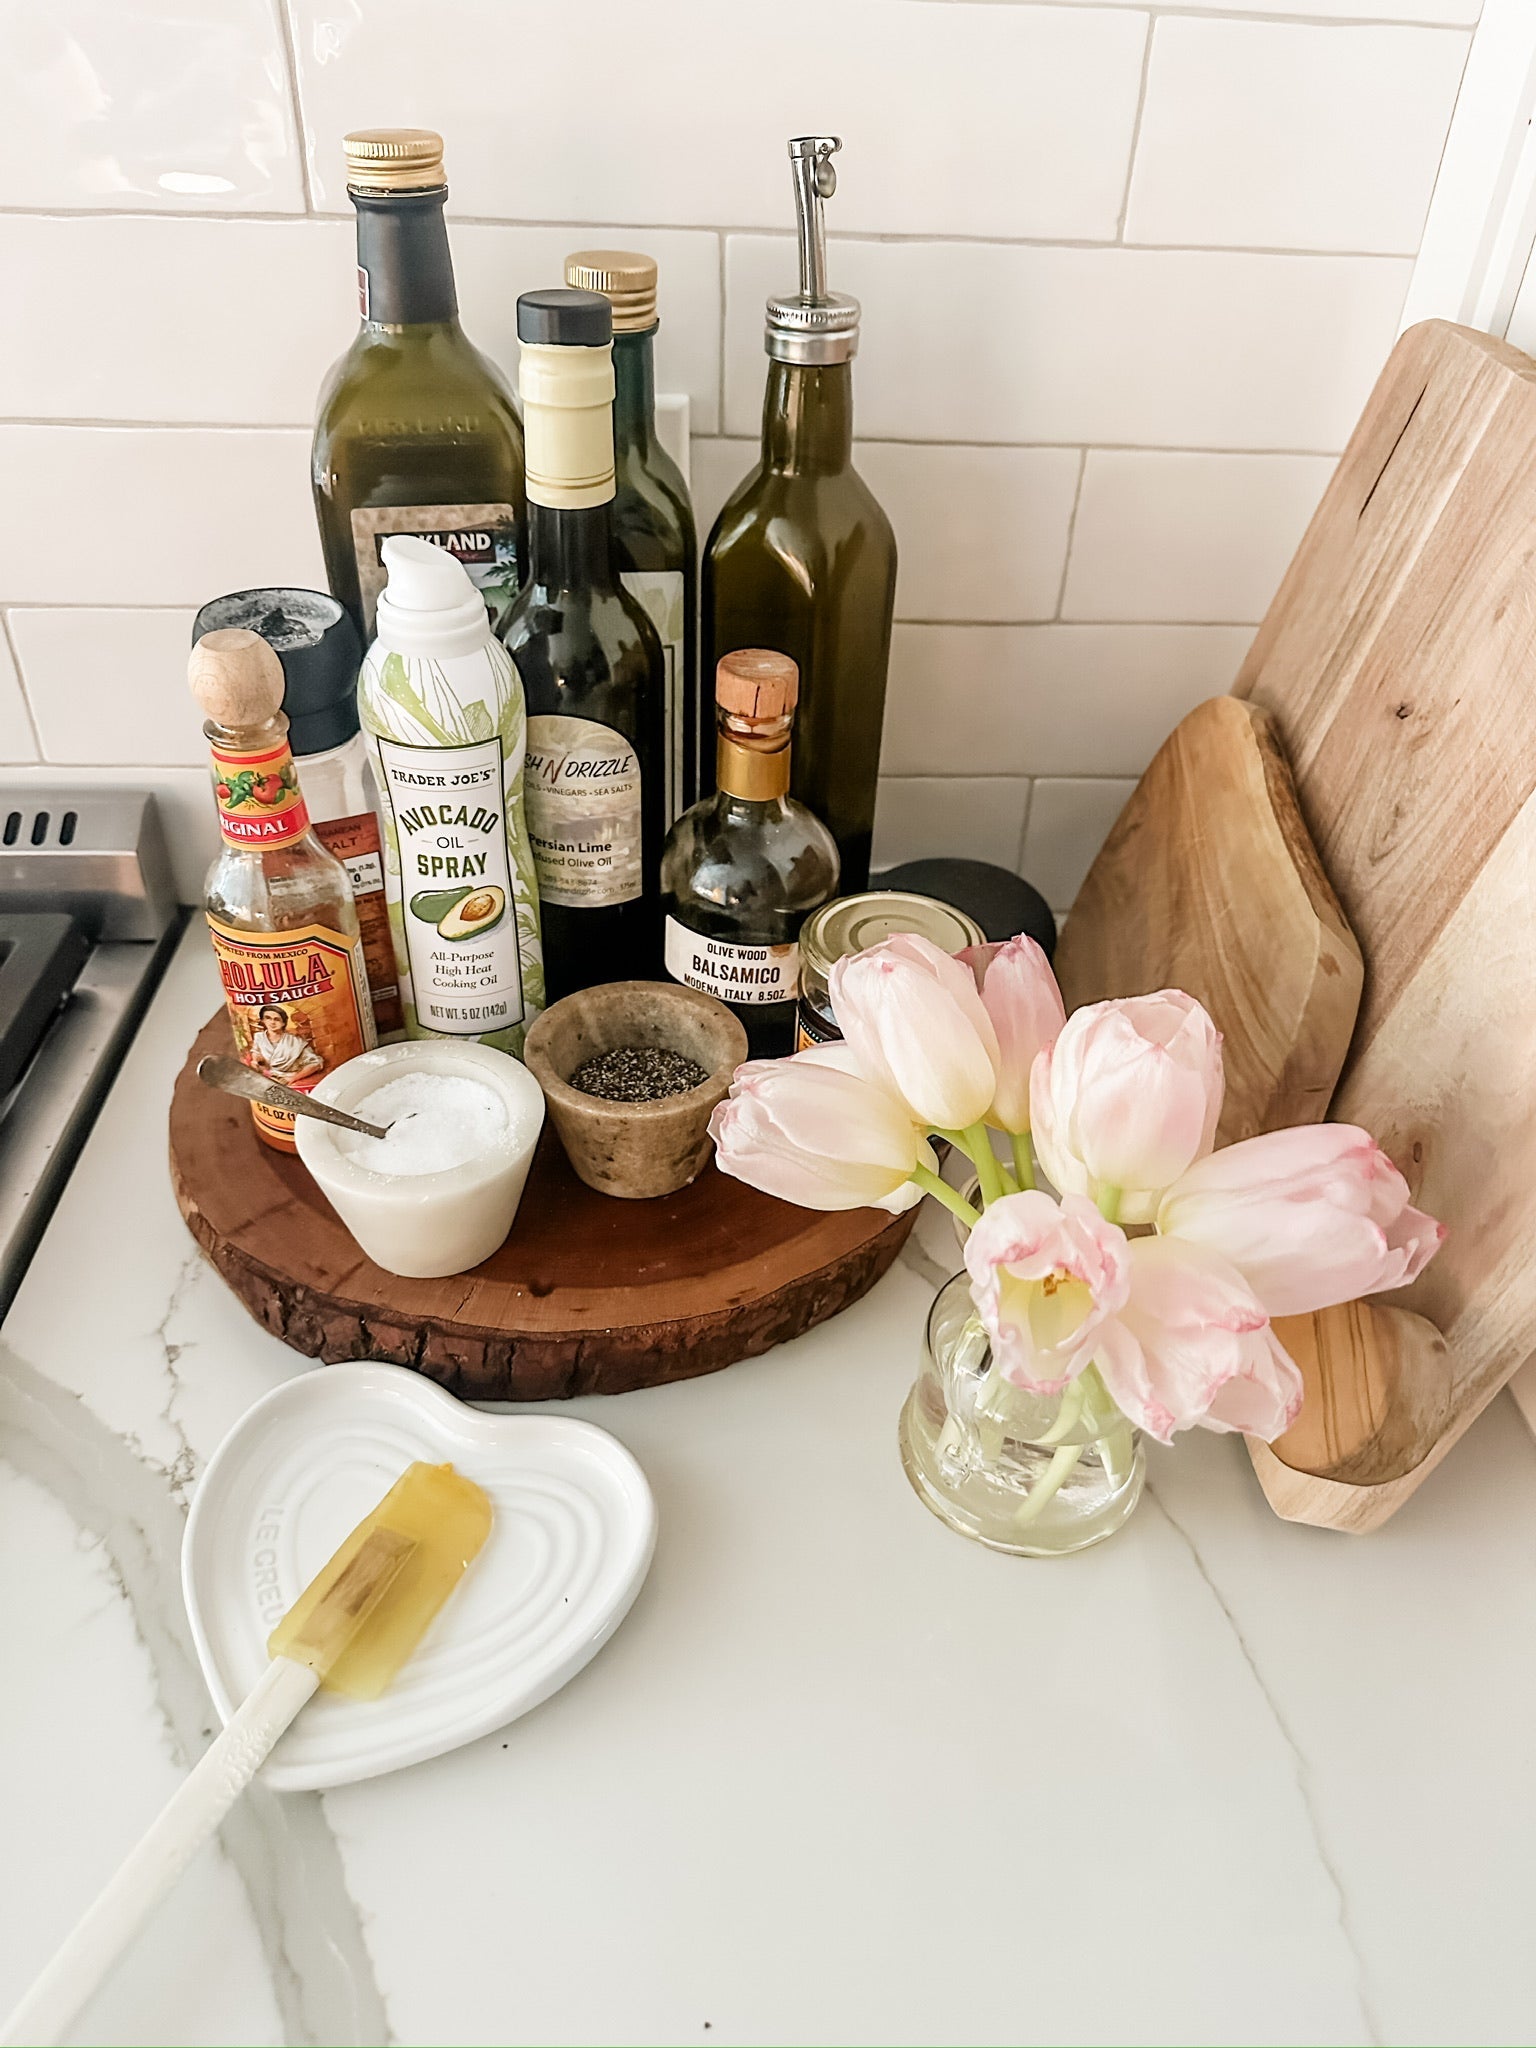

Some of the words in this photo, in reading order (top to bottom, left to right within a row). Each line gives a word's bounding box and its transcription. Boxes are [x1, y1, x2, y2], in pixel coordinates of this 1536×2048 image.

[542, 751, 572, 784] N
[565, 754, 633, 778] DRIZZLE
[391, 769, 446, 786] TRADER
[450, 768, 491, 786] JOE'S
[546, 786, 587, 797] VINEGARS
[594, 788, 609, 797] SEA
[611, 783, 633, 795] SALTS
[399, 805, 499, 836] AVOCADO
[329, 837, 357, 850] ALT
[436, 836, 464, 849] OIL
[578, 842, 612, 853] Lime
[417, 852, 488, 878] SPRAY
[533, 852, 565, 866] nfused
[567, 858, 594, 868] Olive
[597, 857, 612, 867] Oil
[246, 951, 271, 960] FROM
[273, 948, 308, 959] MEXICO
[430, 951, 495, 963] All-Purpose
[707, 942, 734, 959] OLIVE
[737, 949, 767, 961] WOOD
[217, 952, 332, 990] HOLULA
[435, 964, 462, 976] High
[466, 963, 492, 976] Heat
[692, 954, 780, 984] BALSAMICO
[433, 977, 477, 989] Cooking
[480, 975, 498, 986] Oil
[684, 973, 722, 998] MODENA,
[725, 988, 753, 1001] ITALY
[235, 992, 265, 1004] HOT
[269, 984, 322, 1001] SAUCE
[430, 1004, 446, 1018] NET
[446, 1006, 461, 1020] WT.
[462, 1007, 468, 1020] 5
[470, 1007, 481, 1020] OZ
[482, 1002, 507, 1019] (142g)
[262, 1105, 273, 1117] FL
[273, 1110, 286, 1120] OZ
[256, 1507, 284, 1543] LE
